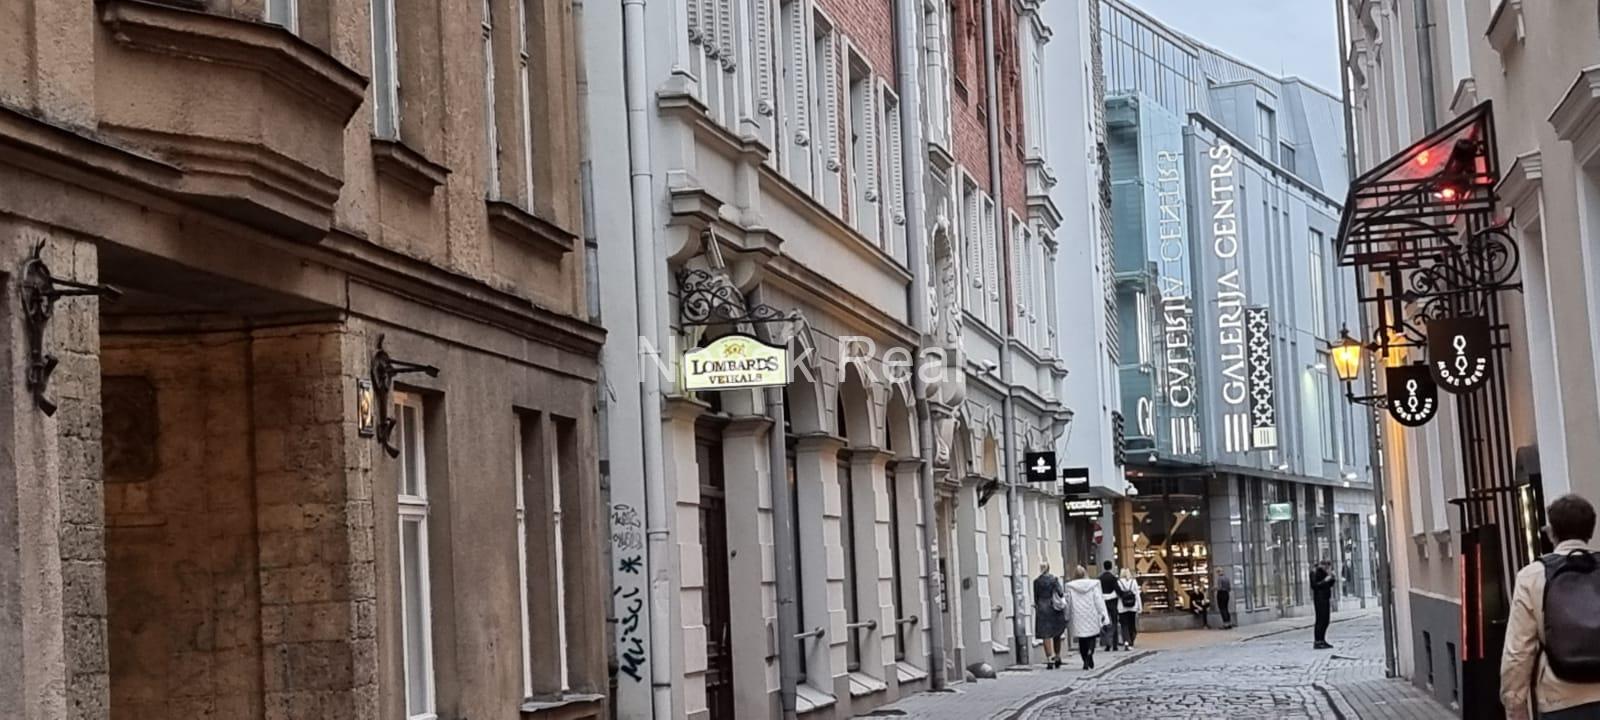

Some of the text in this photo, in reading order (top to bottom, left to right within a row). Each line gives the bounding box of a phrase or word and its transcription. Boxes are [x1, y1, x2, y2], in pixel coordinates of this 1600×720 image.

[1209, 143, 1246, 404] GALERIJA CENTRS
[691, 356, 778, 376] LOMBARDS
[1437, 357, 1486, 387] MORE BEERS
[708, 374, 762, 385] VEIKALS
[1393, 399, 1412, 421] MORE
